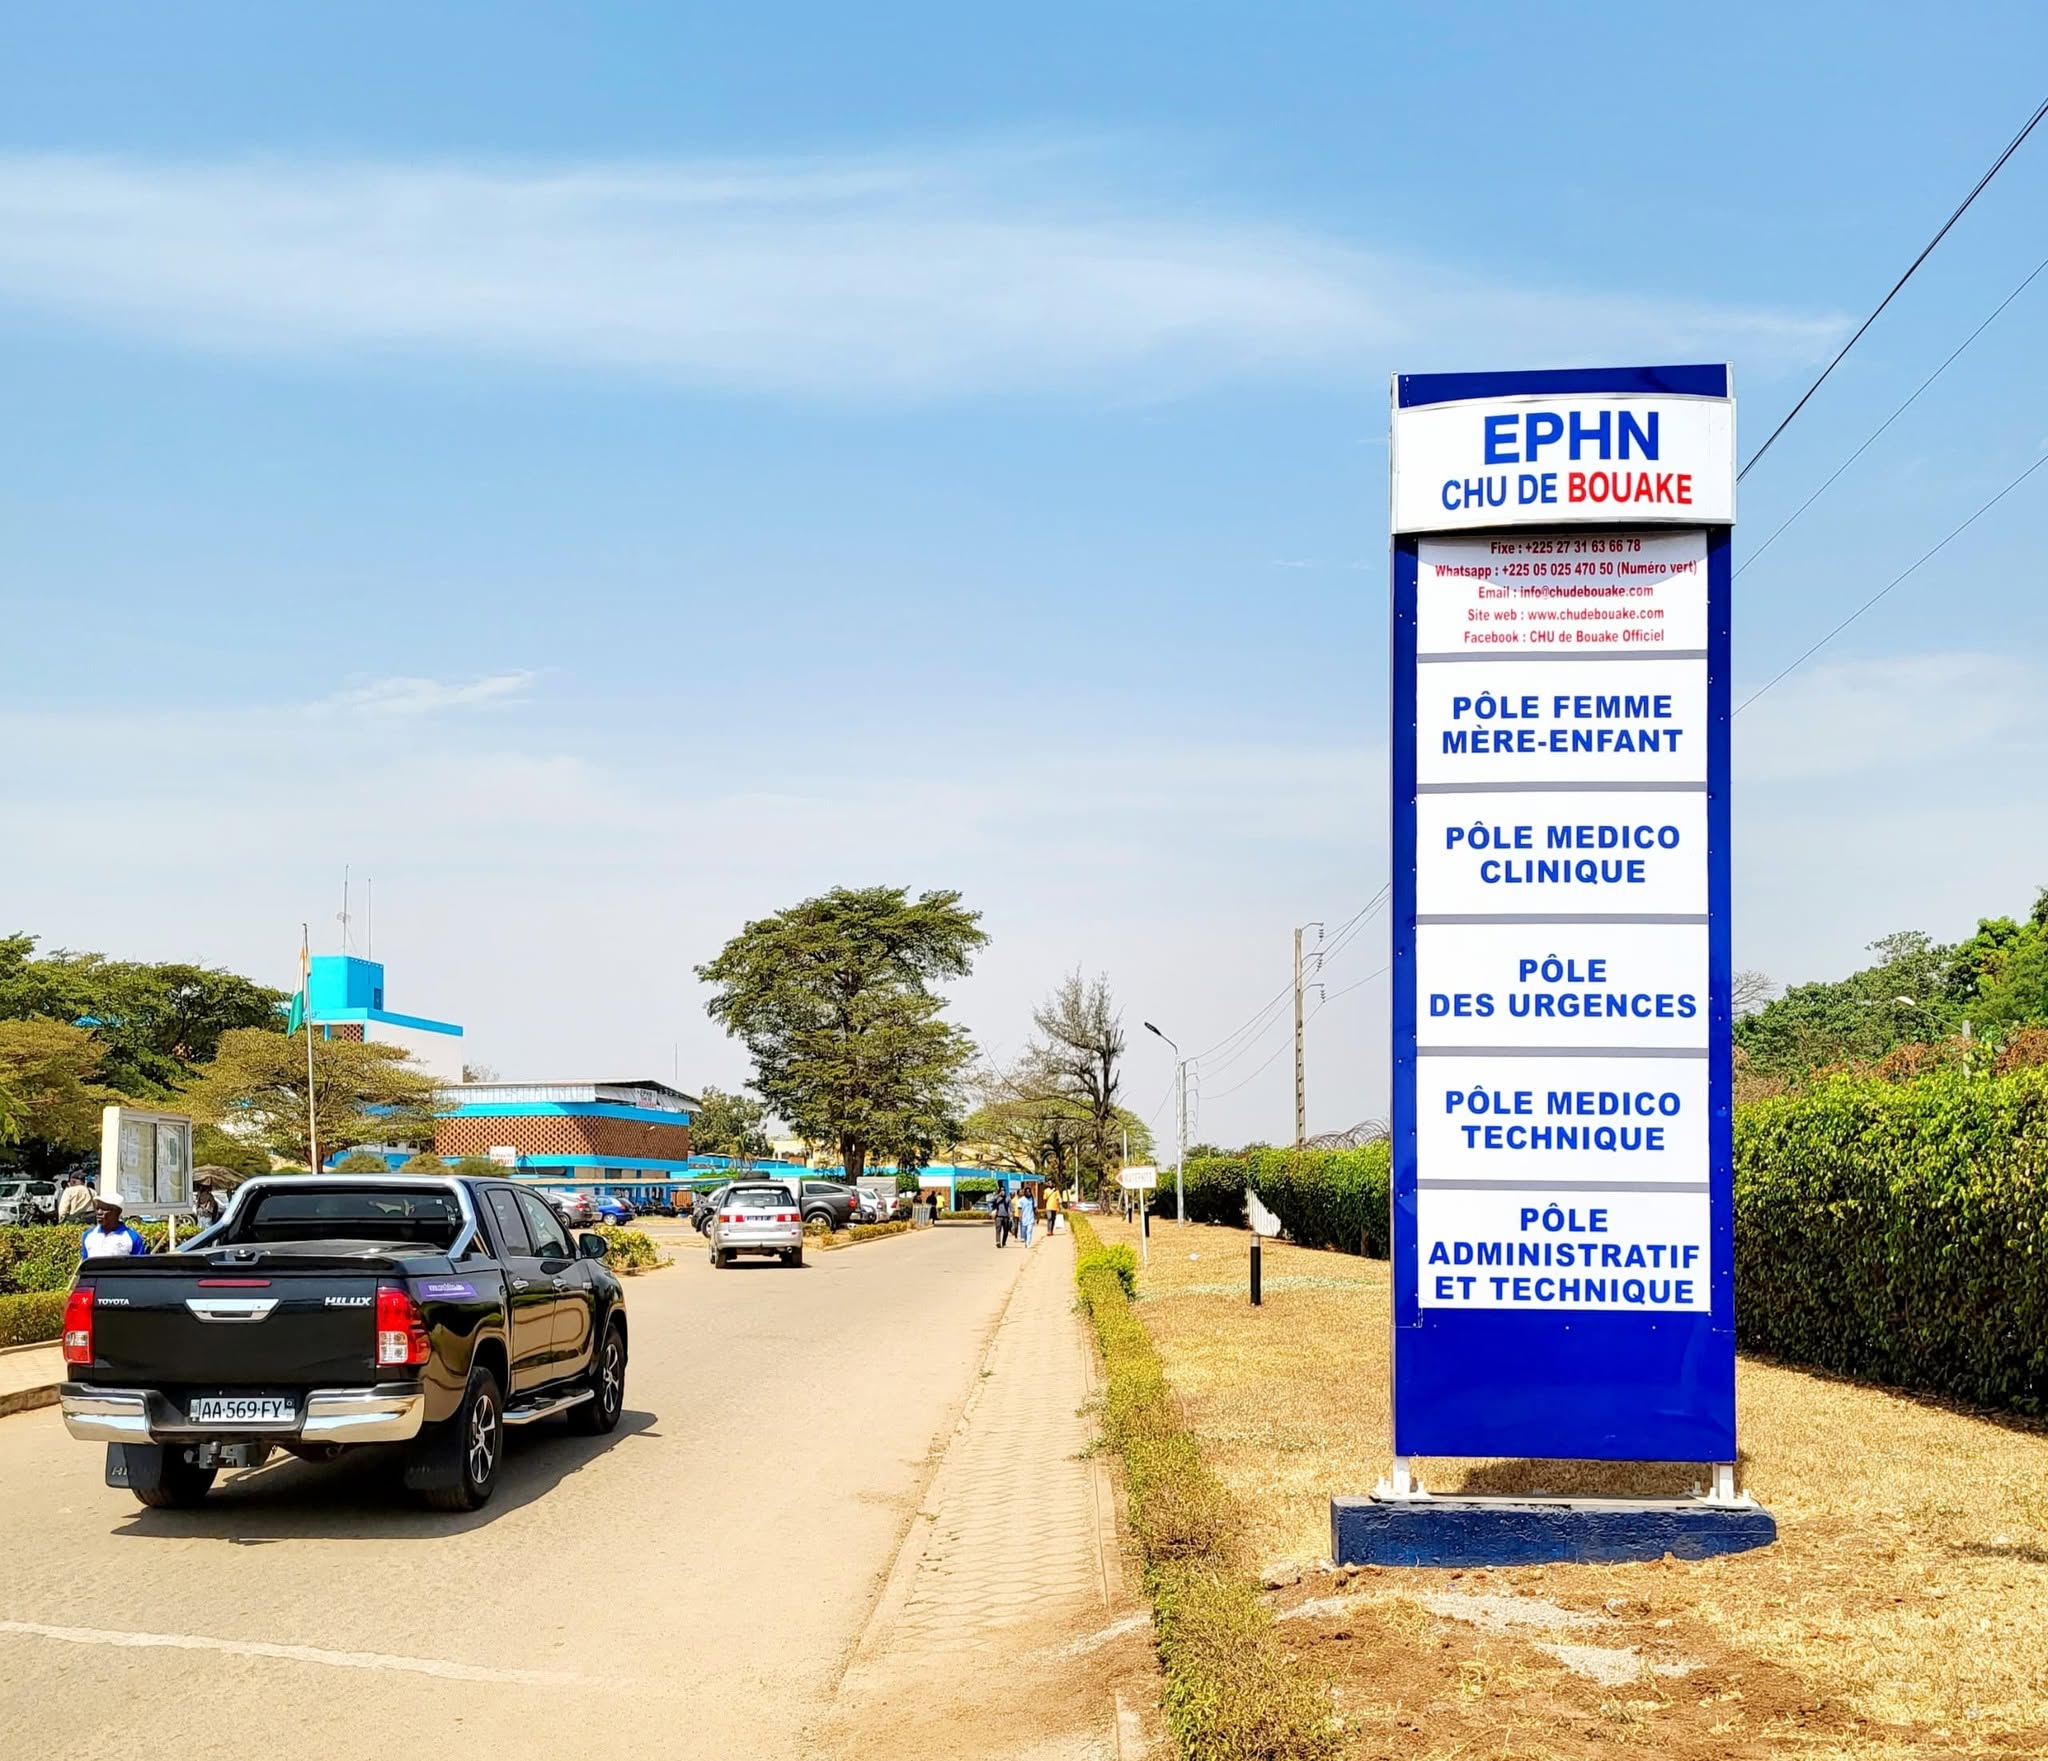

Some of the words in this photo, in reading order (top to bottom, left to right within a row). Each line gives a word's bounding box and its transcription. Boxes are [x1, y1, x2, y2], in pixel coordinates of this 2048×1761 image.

[1484, 411, 1659, 465] EPHN
[1441, 476, 1507, 510] CHU
[1518, 473, 1557, 504] DE
[1568, 471, 1693, 505] BOUAKE
[1490, 541, 1516, 555] Fixe
[1525, 541, 1554, 554] +225
[1556, 541, 1571, 554] 27
[1574, 540, 1587, 553] 31
[1591, 540, 1605, 553] 63
[1609, 540, 1624, 553] 66
[1626, 539, 1641, 552] 78
[1435, 564, 1492, 579] Whatsapp
[1502, 564, 1530, 577] +225
[1533, 563, 1547, 576] 05
[1550, 563, 1571, 576] 025
[1574, 563, 1596, 575] 470
[1599, 562, 1613, 575] 50
[1617, 561, 1667, 578] (Numéro
[1670, 561, 1697, 575] vert)
[1478, 586, 1509, 599] Email
[1520, 585, 1654, 598] info@chudebouake.com
[1468, 609, 1488, 621] Site
[1493, 609, 1517, 621] web
[1528, 608, 1664, 621] www.chudebouake.com
[1464, 631, 1519, 643] Facebook
[1530, 631, 1555, 643] CHU
[1559, 631, 1572, 642] de
[1576, 630, 1618, 642] Bouake
[1623, 629, 1664, 642] Officiel
[1453, 691, 1539, 720] PÔLE
[1554, 695, 1672, 718] FEMME
[1442, 725, 1683, 754] MÈRE-ENFANT
[1446, 821, 1533, 850] PÔLE
[1547, 825, 1681, 849] MEDICO
[1480, 859, 1646, 885] CLINIQUE
[1519, 954, 1607, 983] PÔLE
[1430, 993, 1495, 1017] DES
[1509, 993, 1697, 1018] URGENCES
[1446, 1085, 1533, 1115] PÔLE
[1548, 1091, 1681, 1116] MEDICO
[1461, 1125, 1665, 1152] TECHNIQUE
[1520, 1202, 1608, 1233] PÔLE
[1428, 1241, 1700, 1269] ADMINISTRATIF
[324, 1296, 372, 1306] HILUX
[1435, 1276, 1477, 1301] ET
[1489, 1277, 1694, 1305] TECHNIQUE
